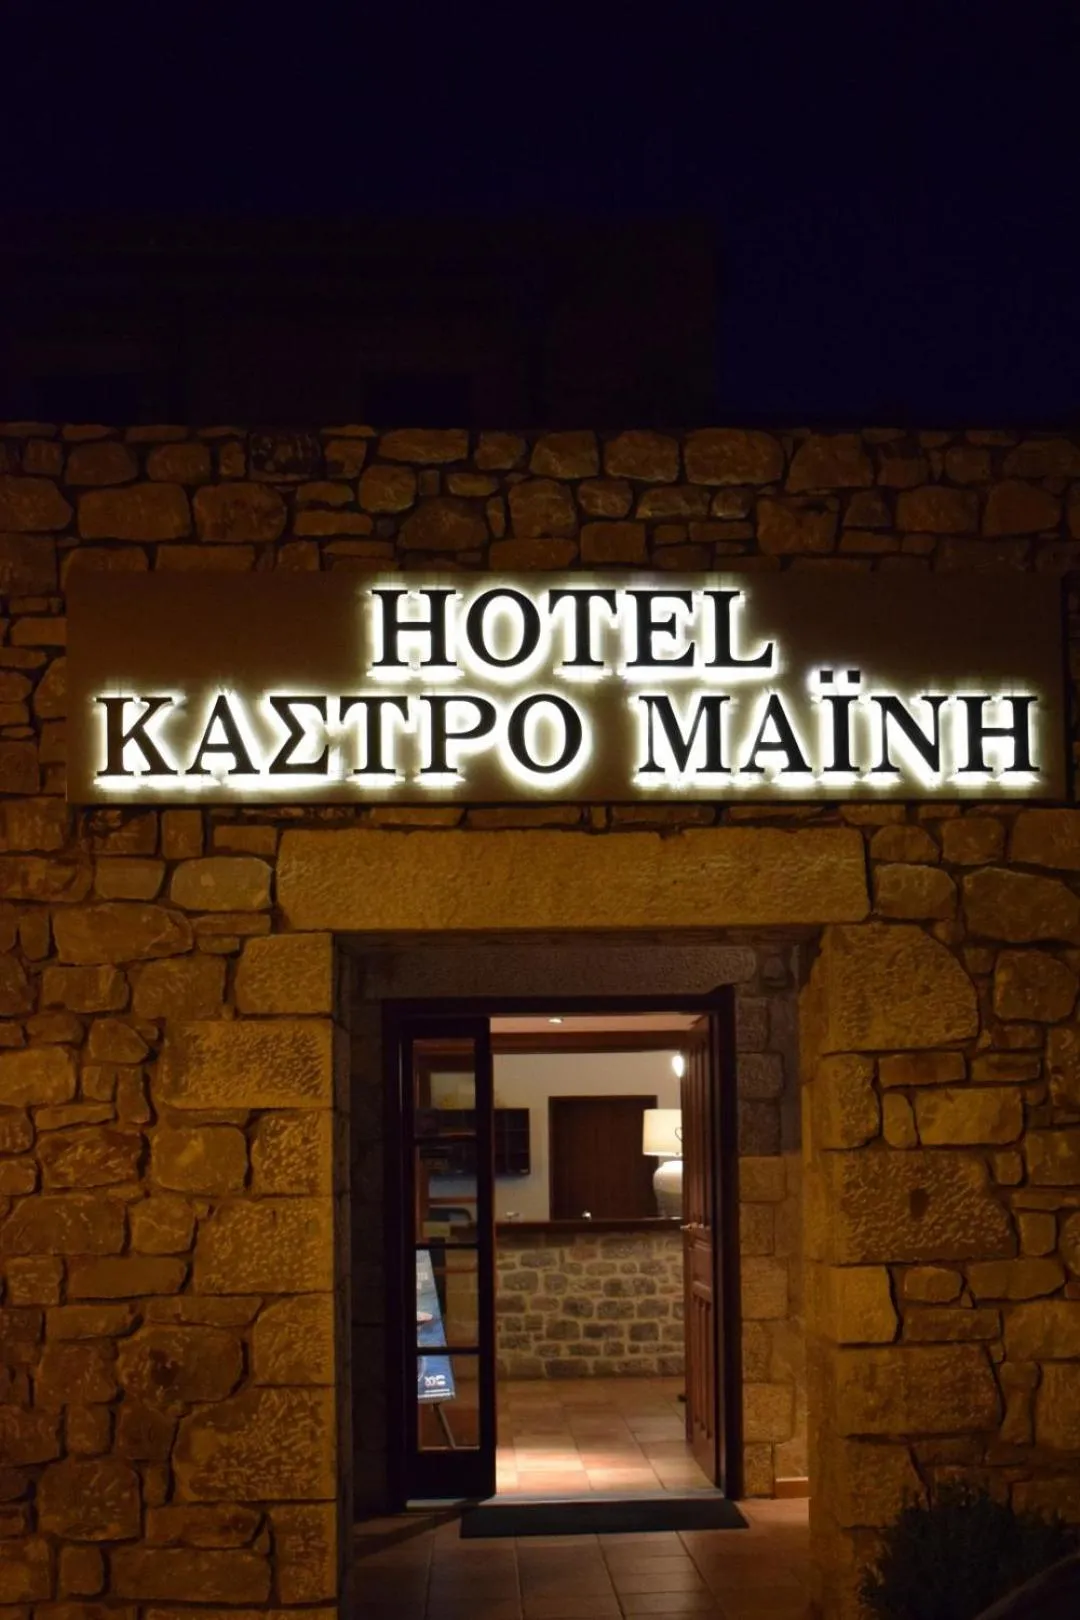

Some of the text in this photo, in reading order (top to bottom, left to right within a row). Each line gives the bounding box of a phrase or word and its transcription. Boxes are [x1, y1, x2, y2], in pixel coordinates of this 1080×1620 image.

[371, 588, 774, 668] HOTEL
[95, 670, 1039, 777] ΚΑΣΤΡΟ ΜΑΪΝΗ
